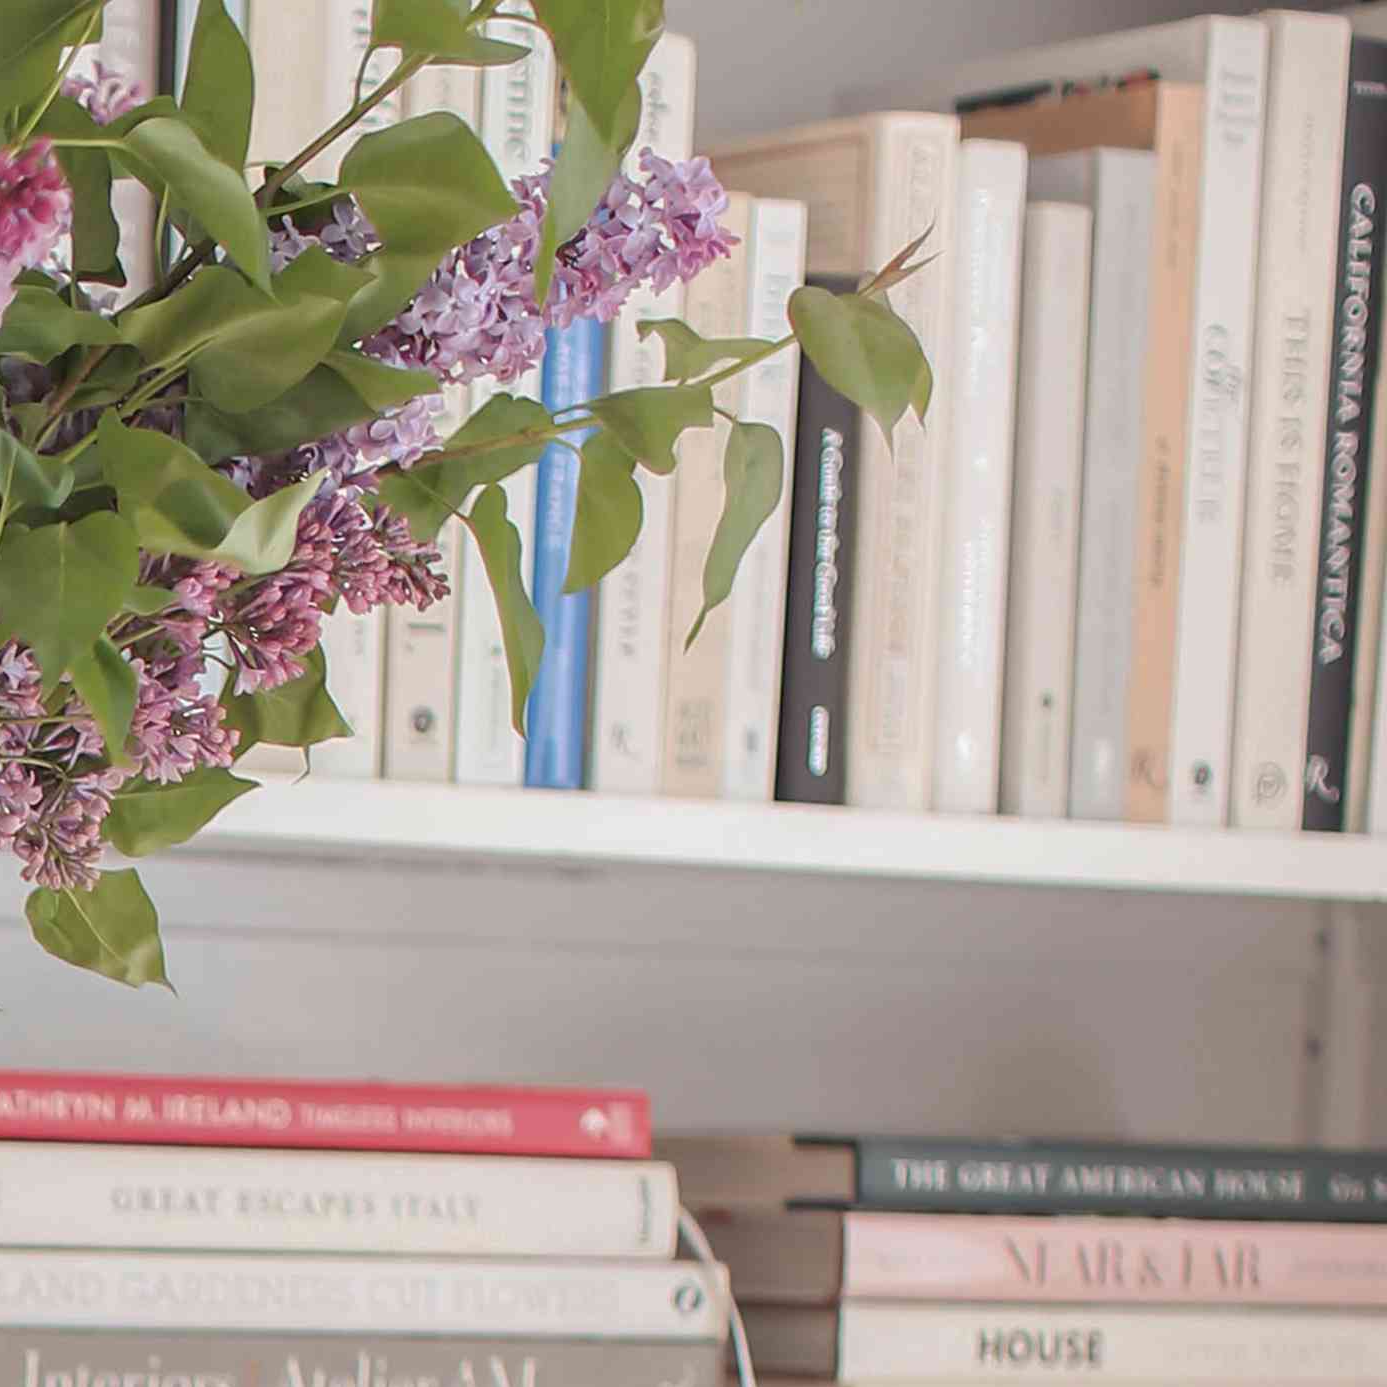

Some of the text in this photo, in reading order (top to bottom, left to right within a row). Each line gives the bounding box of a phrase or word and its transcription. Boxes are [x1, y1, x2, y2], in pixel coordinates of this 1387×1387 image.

[1319, 183, 1375, 664] CALIFORNIA ROMANTICA
[1270, 308, 1309, 585] THIS IS HOME
[163, 1093, 293, 1130] IRELAND
[891, 1157, 952, 1192] THE
[958, 1160, 1053, 1195] GREAT
[1061, 1163, 1206, 1199] AMERICAN
[1213, 1168, 1306, 1202] HOUSE
[109, 1186, 482, 1222] GREAT ESCAPES ITALY
[116, 1270, 355, 1314] GARDENERS
[367, 1275, 435, 1313] CUT
[978, 1329, 1105, 1367] HOUSE
